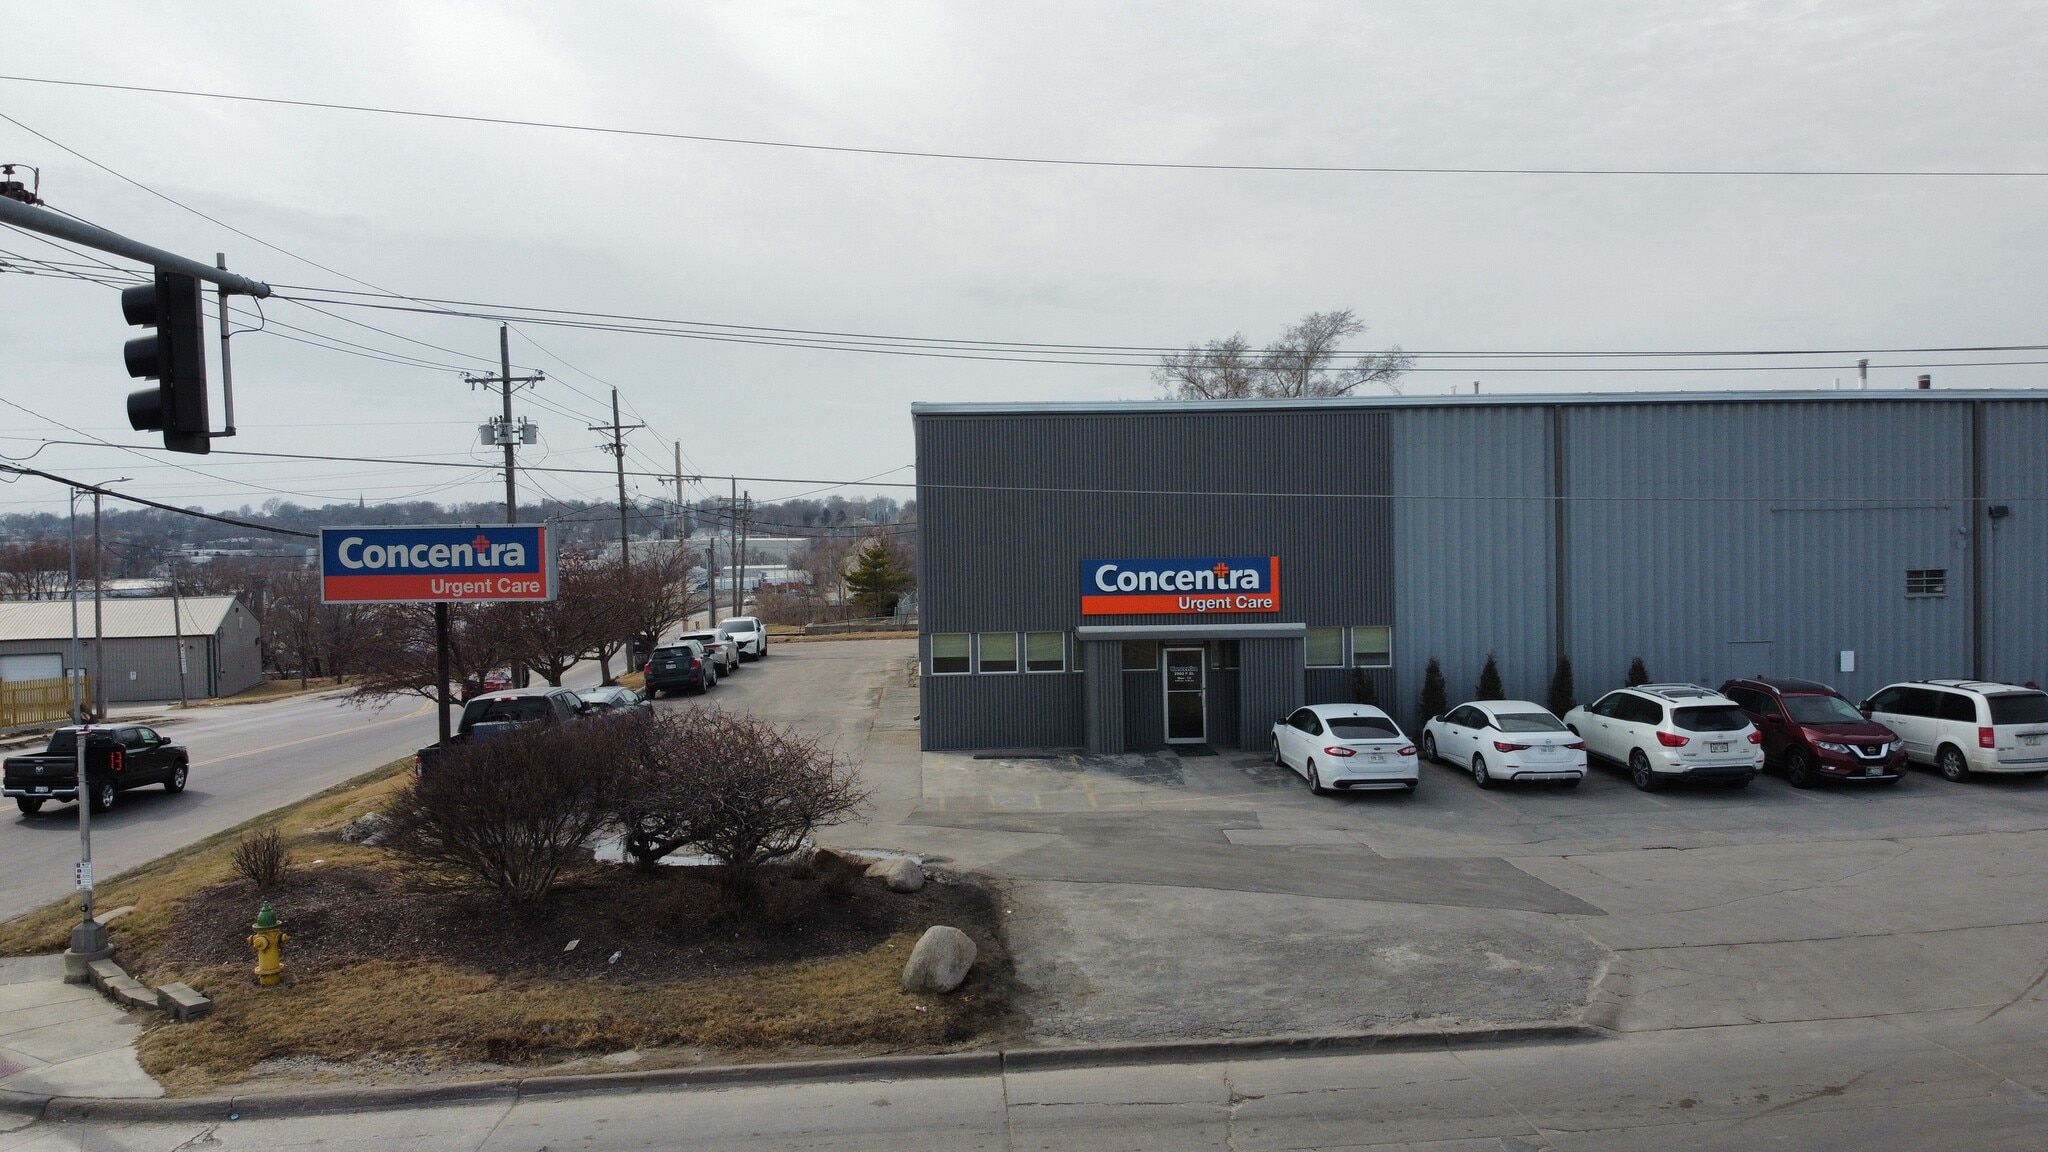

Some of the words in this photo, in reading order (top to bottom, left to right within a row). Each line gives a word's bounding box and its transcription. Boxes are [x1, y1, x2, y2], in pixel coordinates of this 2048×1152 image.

[338, 535, 526, 569] Concentra
[431, 578, 492, 597] Urgent
[497, 577, 541, 593] Care
[1095, 562, 1260, 592] Concentra
[1178, 596, 1232, 612] Urgent
[1235, 595, 1273, 609] Care
[110, 751, 122, 771] 13
